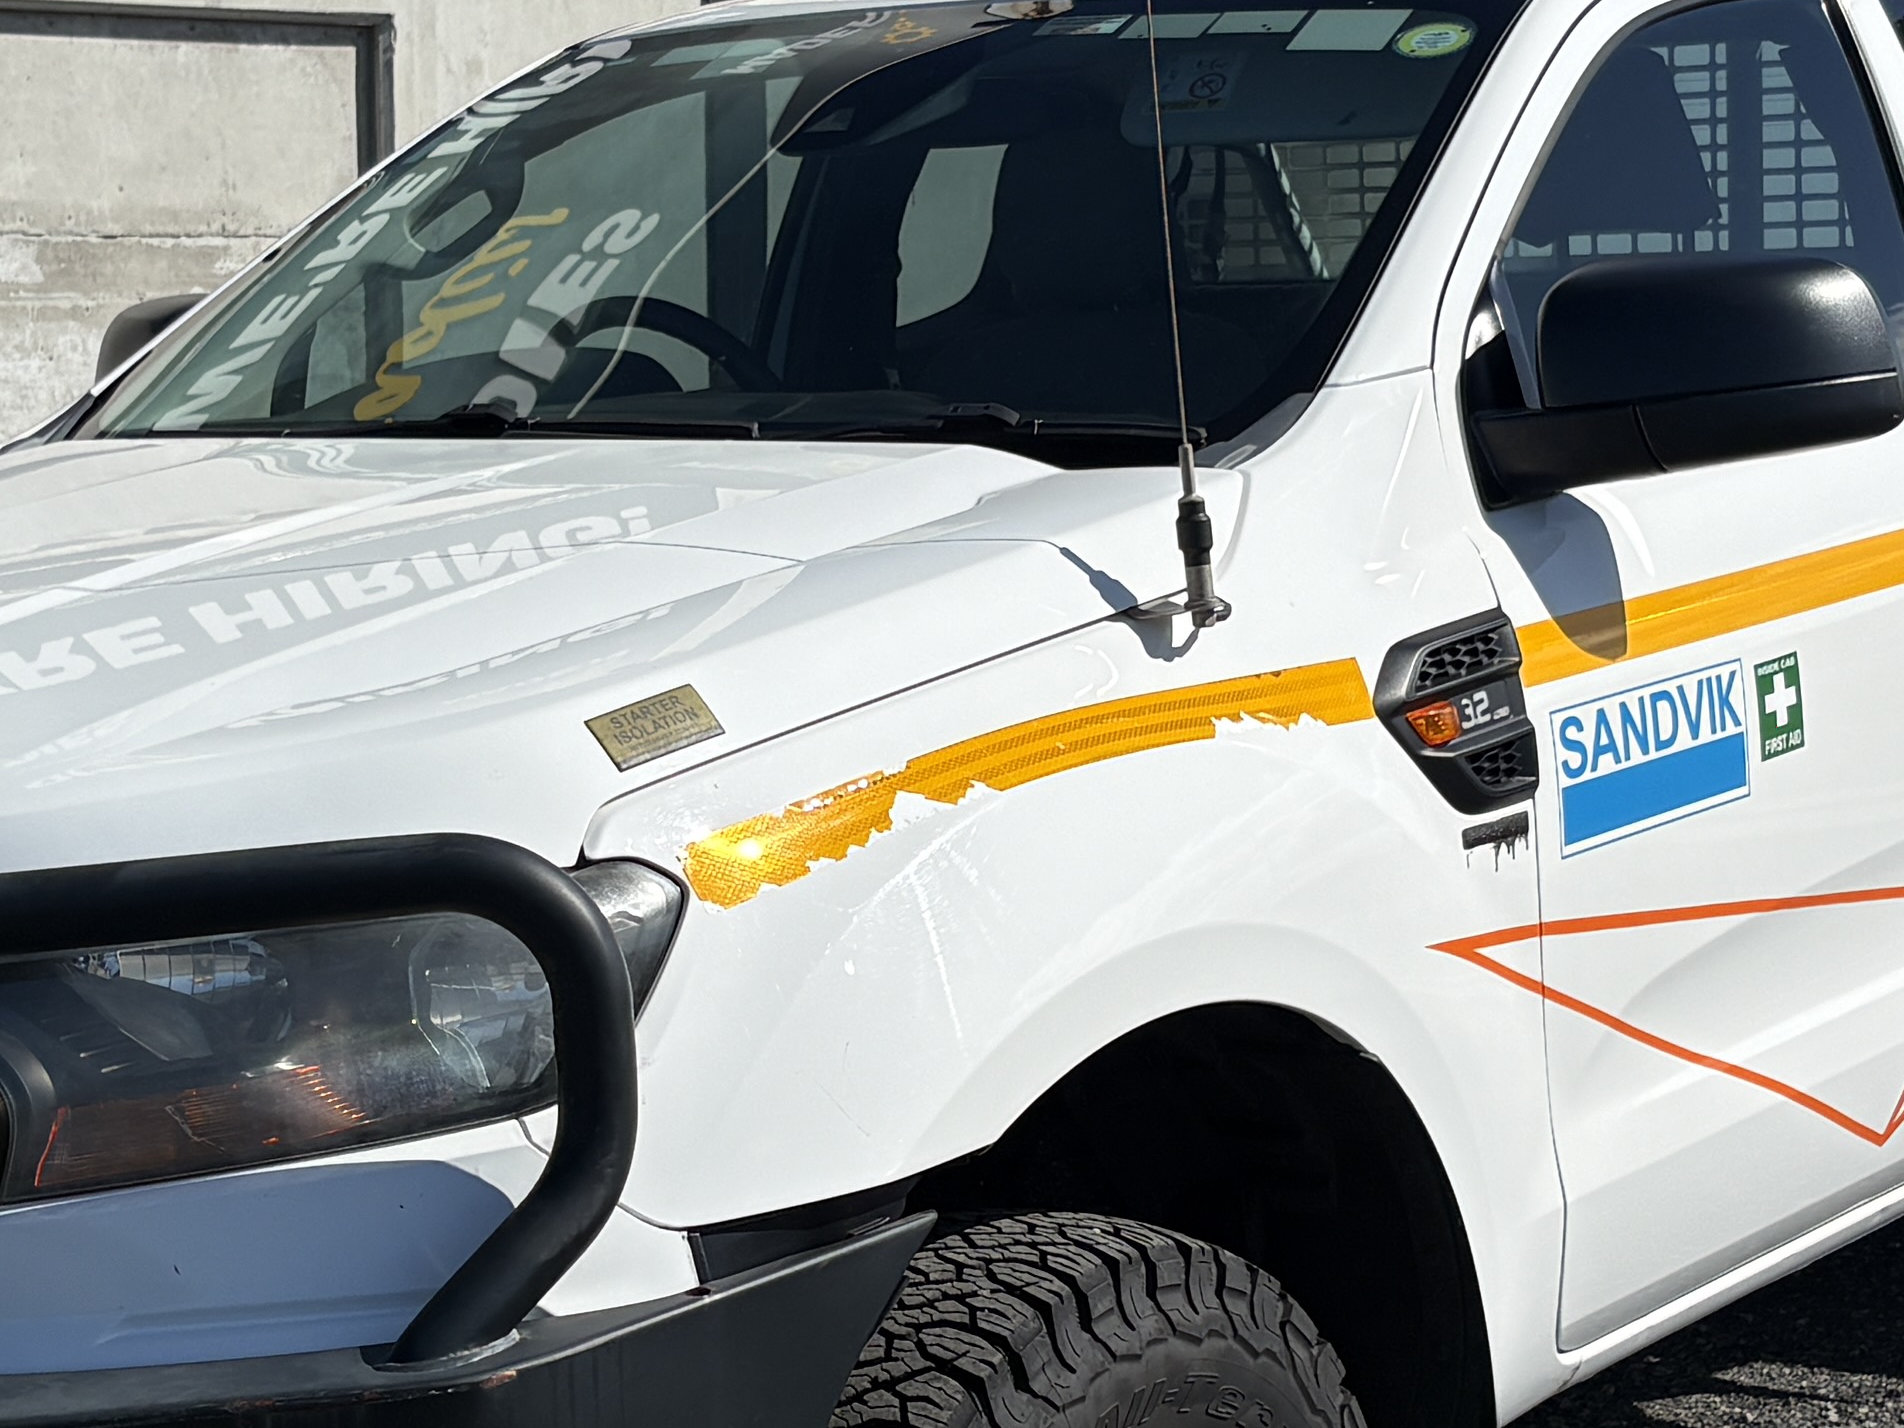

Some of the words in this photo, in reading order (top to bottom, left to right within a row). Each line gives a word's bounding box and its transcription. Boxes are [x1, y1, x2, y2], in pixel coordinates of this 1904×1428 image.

[1780, 655, 1795, 669] CAB
[610, 695, 683, 730] STARTER
[613, 707, 700, 746] ISOLATION
[1558, 669, 1742, 780] SANDVIK
[1765, 733, 1788, 755] FIRST
[1788, 728, 1802, 747] AID
